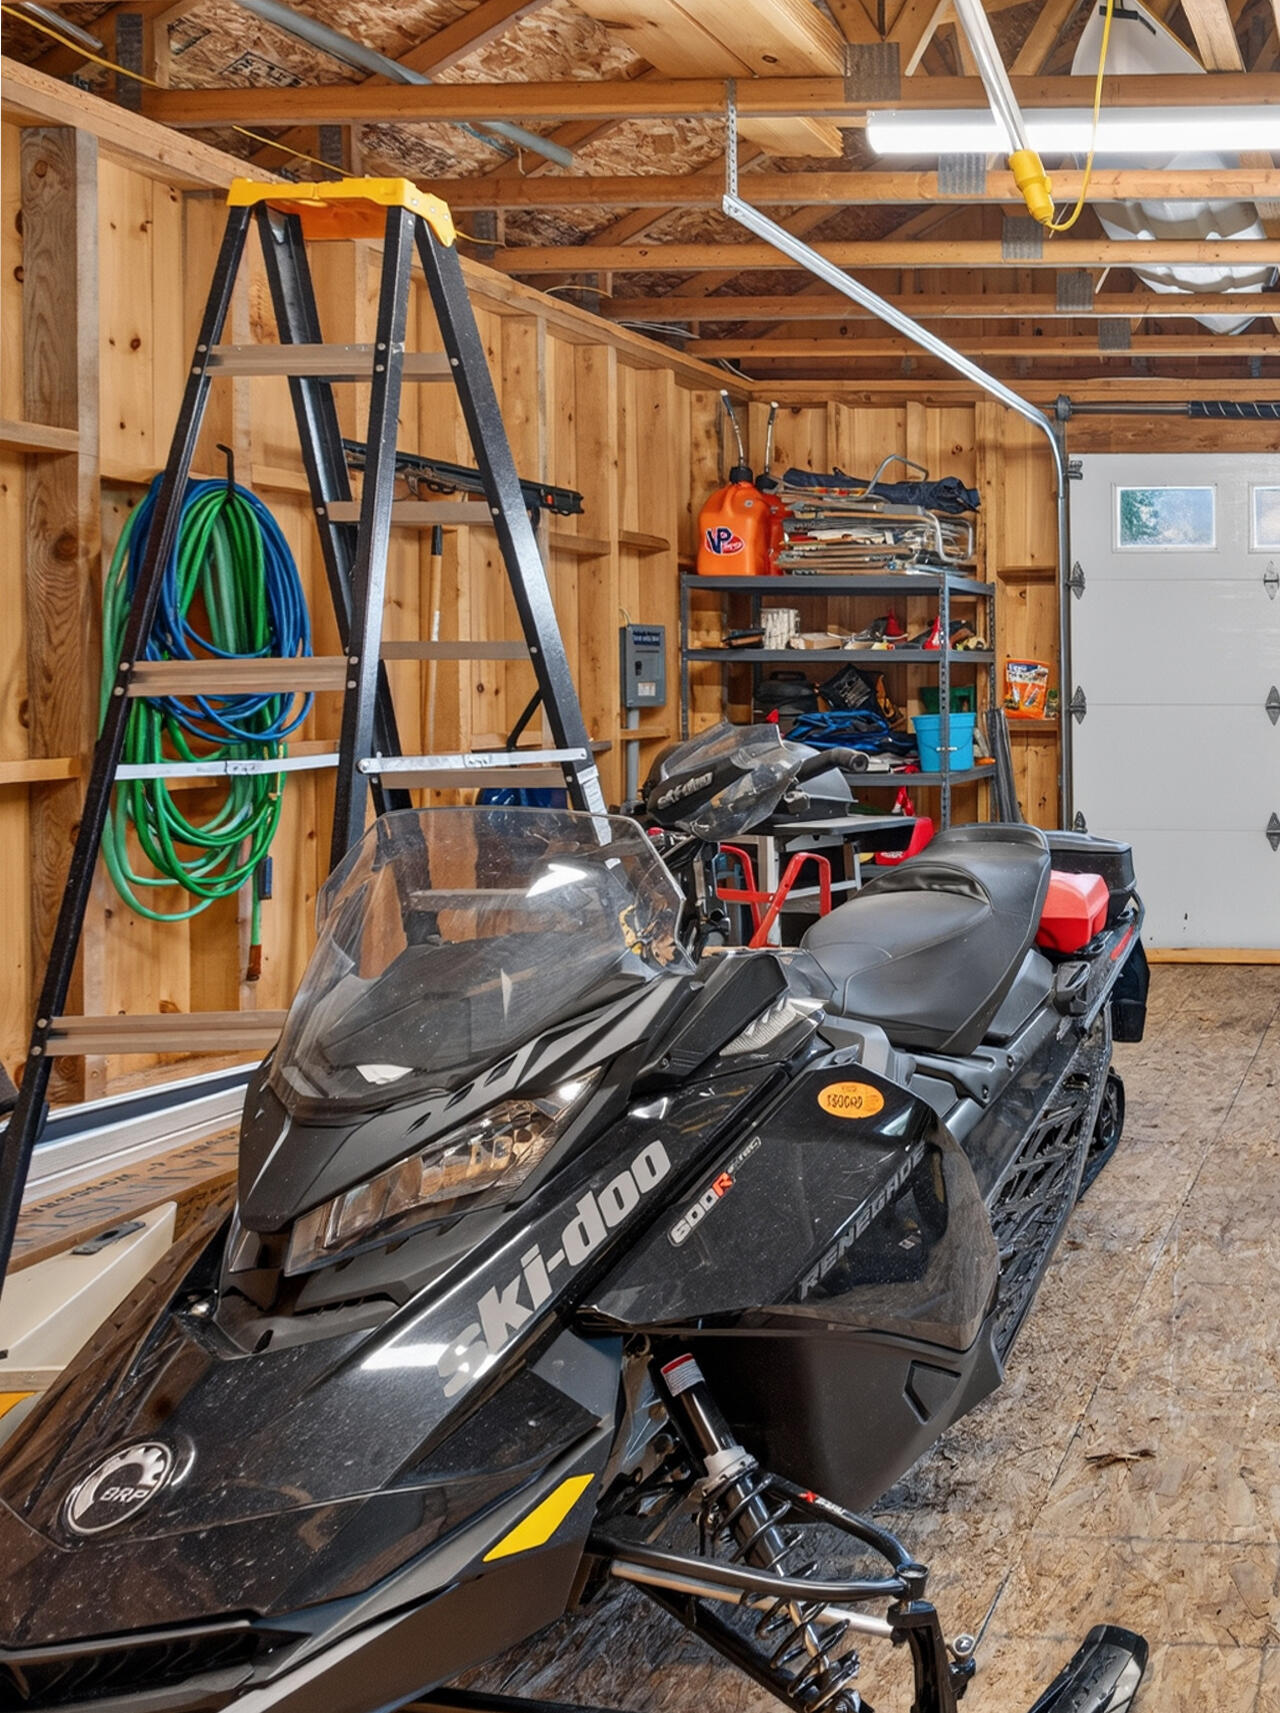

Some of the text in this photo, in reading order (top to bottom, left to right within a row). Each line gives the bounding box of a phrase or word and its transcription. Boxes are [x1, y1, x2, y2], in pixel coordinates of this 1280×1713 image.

[706, 527, 732, 555] VP
[800, 1139, 926, 1300] RENEGADE
[437, 1139, 672, 1398] ski-doo
[100, 1486, 152, 1502] BRP
